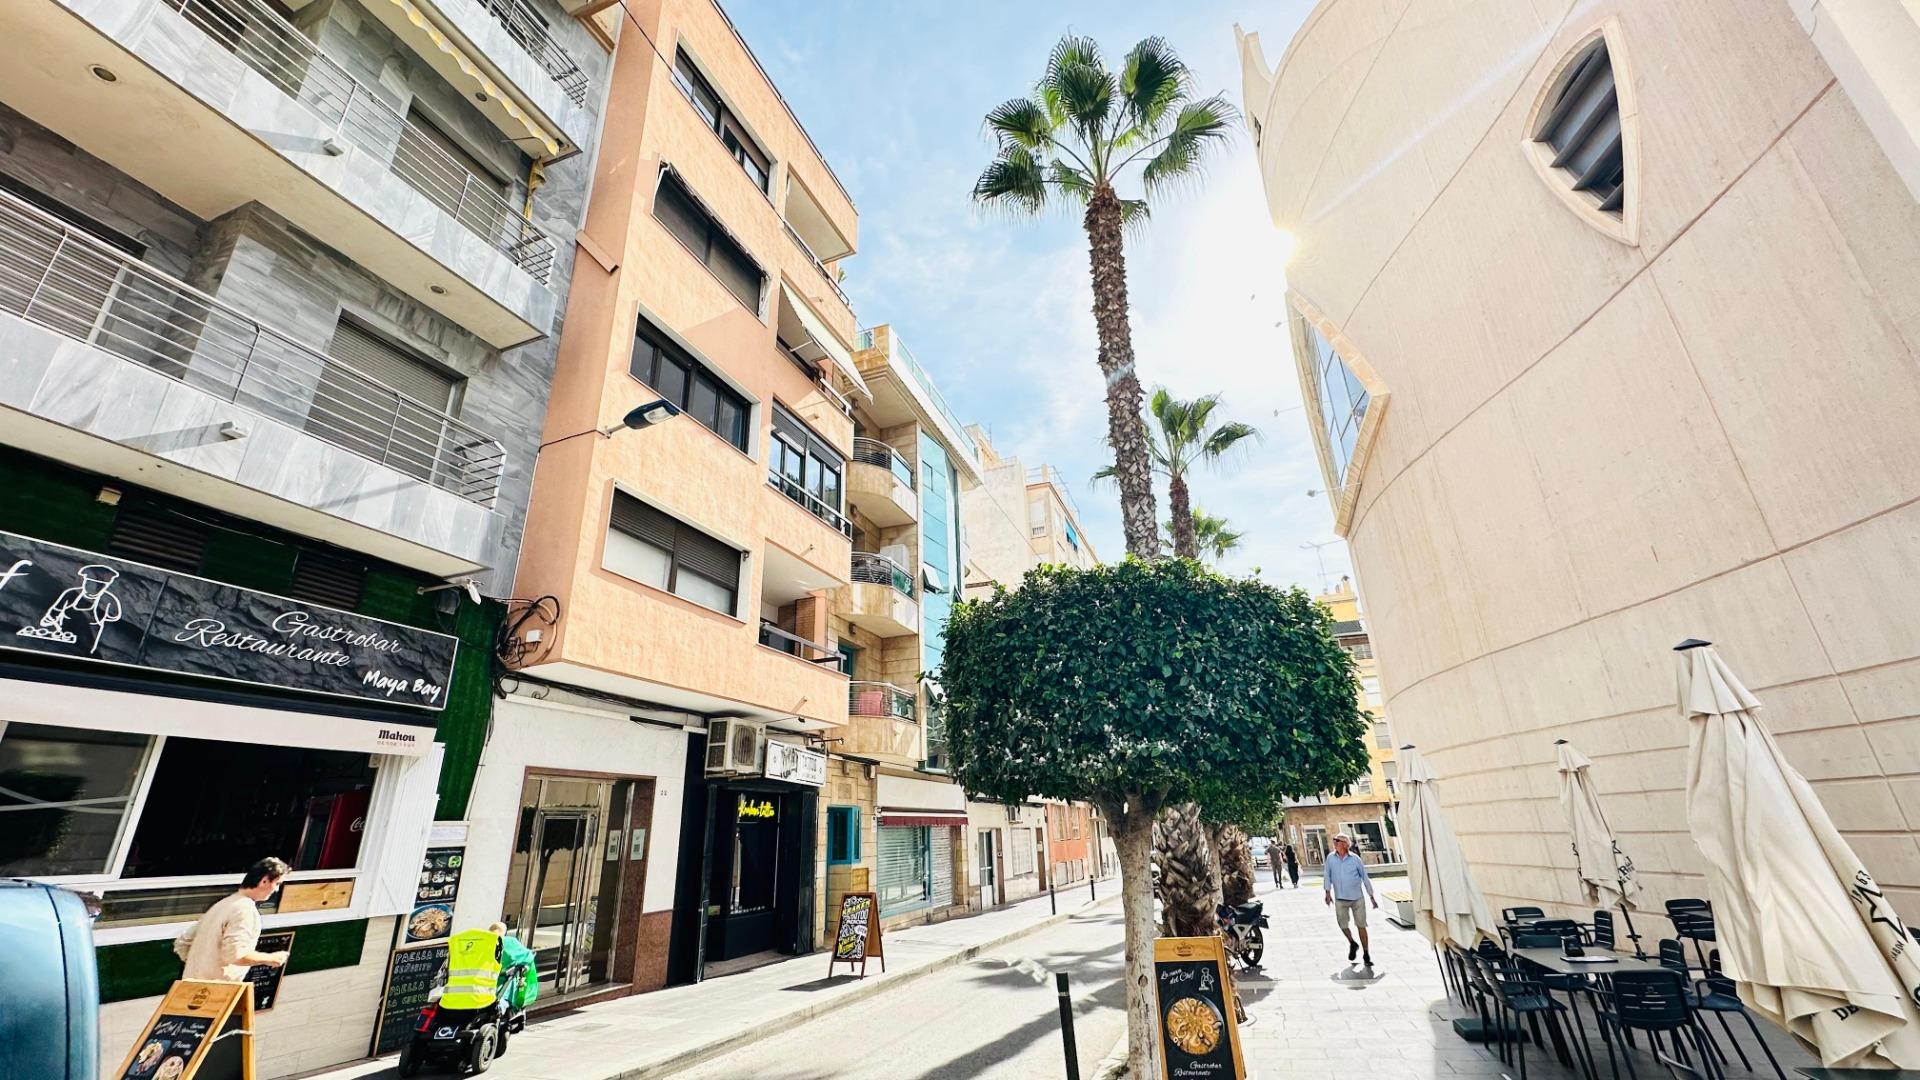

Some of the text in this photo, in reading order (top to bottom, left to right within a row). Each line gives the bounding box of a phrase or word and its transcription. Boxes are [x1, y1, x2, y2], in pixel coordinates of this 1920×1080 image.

[174, 618, 351, 668] Restaurante
[272, 611, 402, 654] Gastrobar
[362, 669, 442, 704] Maya Bay
[378, 729, 416, 742] Mahou
